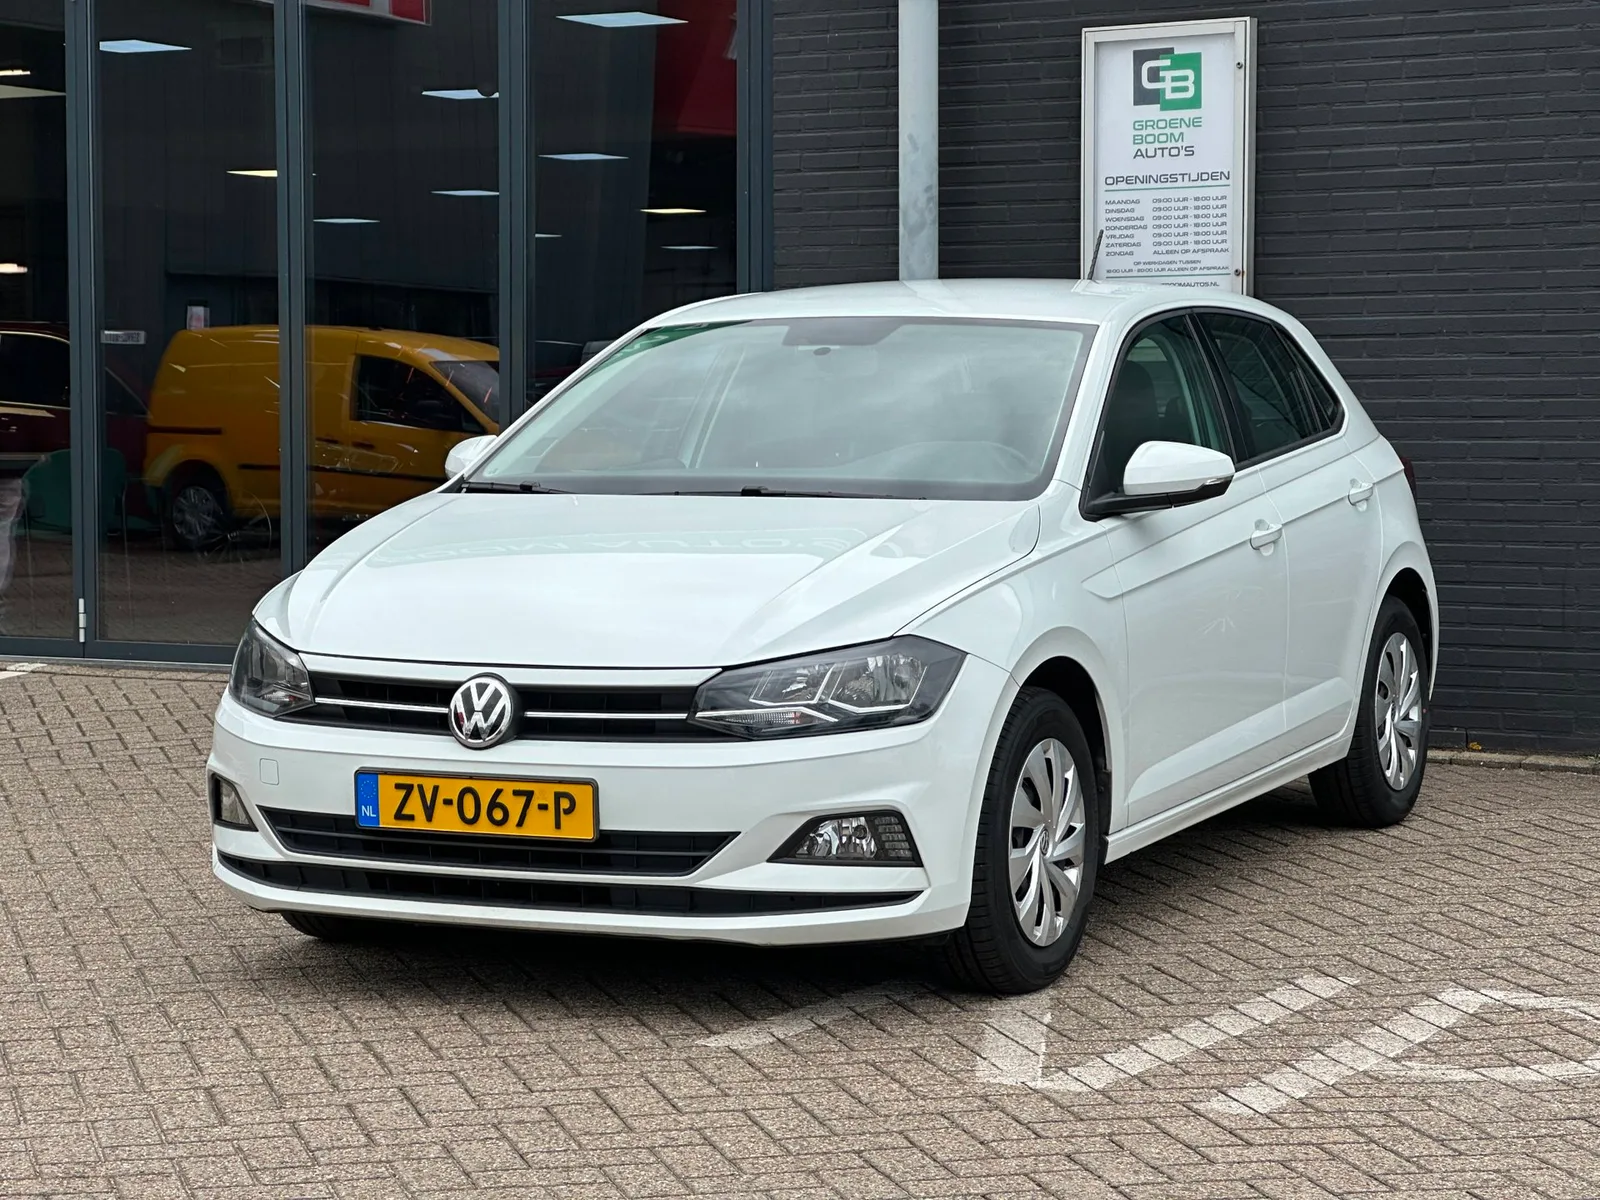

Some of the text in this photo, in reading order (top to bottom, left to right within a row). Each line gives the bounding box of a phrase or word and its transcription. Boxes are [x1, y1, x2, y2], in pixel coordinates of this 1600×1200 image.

[1132, 116, 1202, 131] GROENE
[1132, 132, 1184, 145] BOOM
[1133, 146, 1195, 160] AUTO'S
[1104, 170, 1230, 186] OPENINGSTIJDEN
[361, 783, 576, 830] NL ZV-067-P
